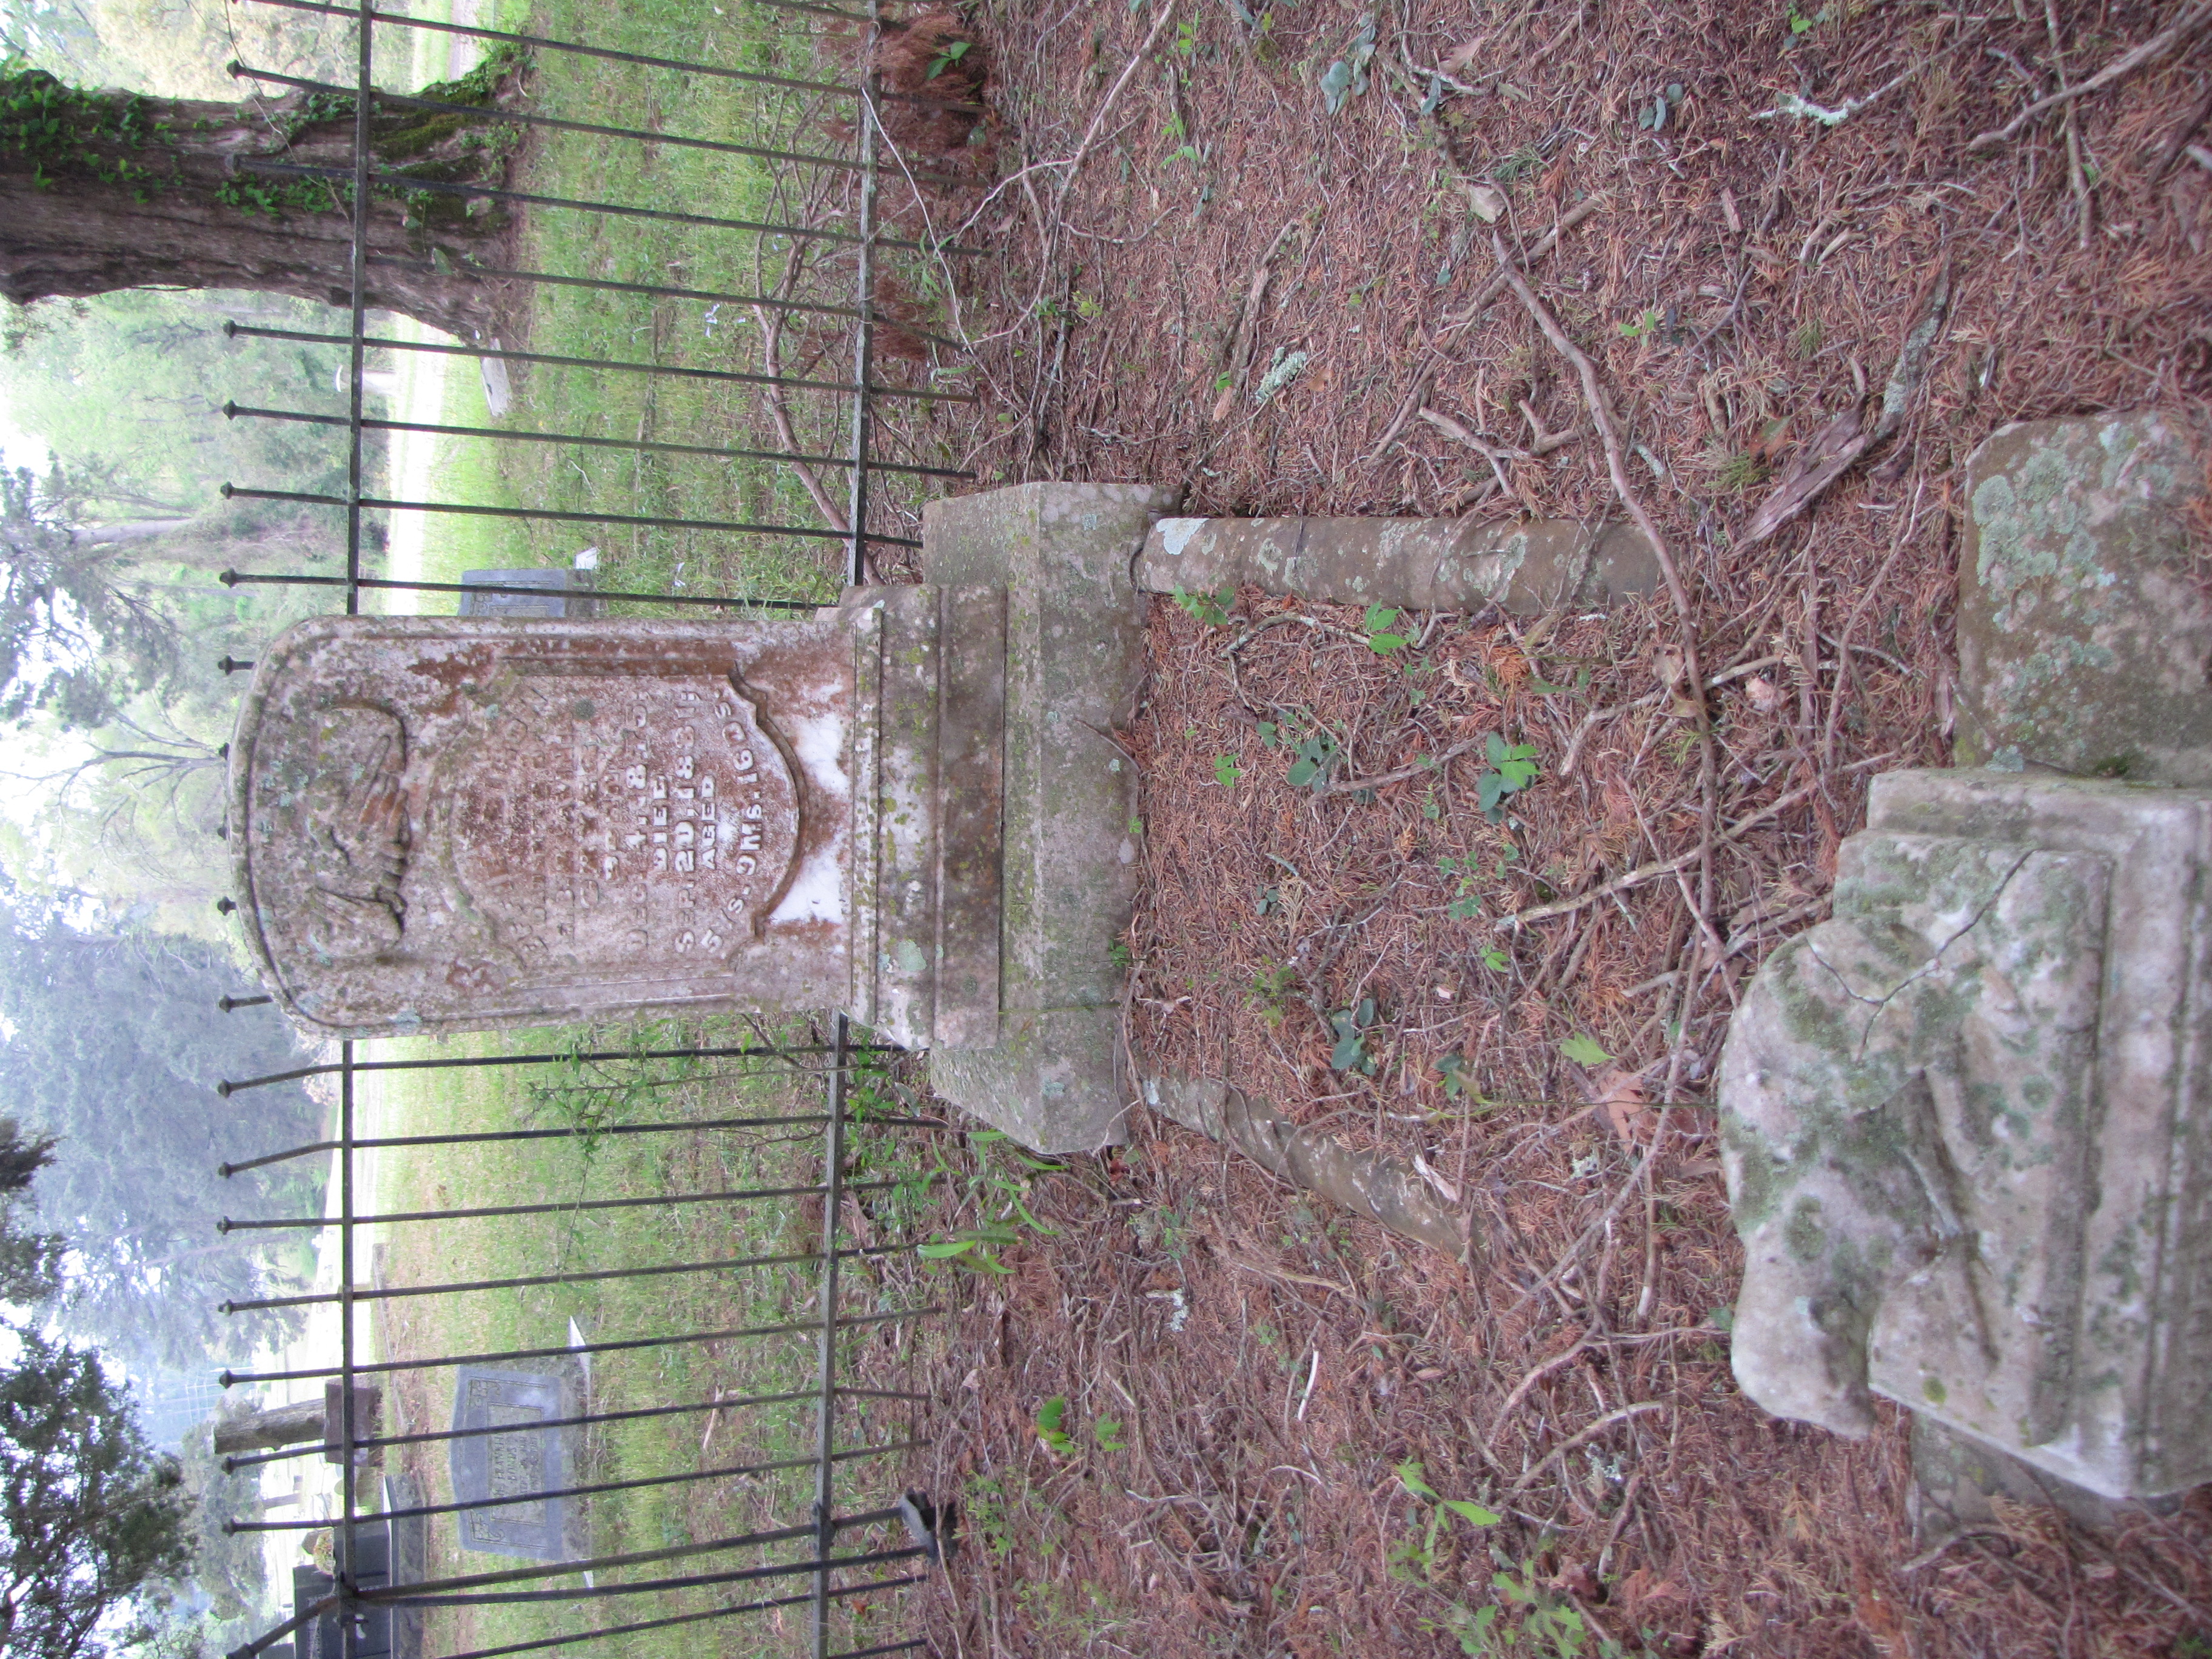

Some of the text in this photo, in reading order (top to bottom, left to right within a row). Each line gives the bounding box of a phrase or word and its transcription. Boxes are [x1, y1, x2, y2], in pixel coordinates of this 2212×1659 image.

[653, 774, 668, 871] DIED
[701, 774, 716, 870] AGED
[625, 872, 648, 950] DEC.
[674, 880, 695, 953] SEP.
